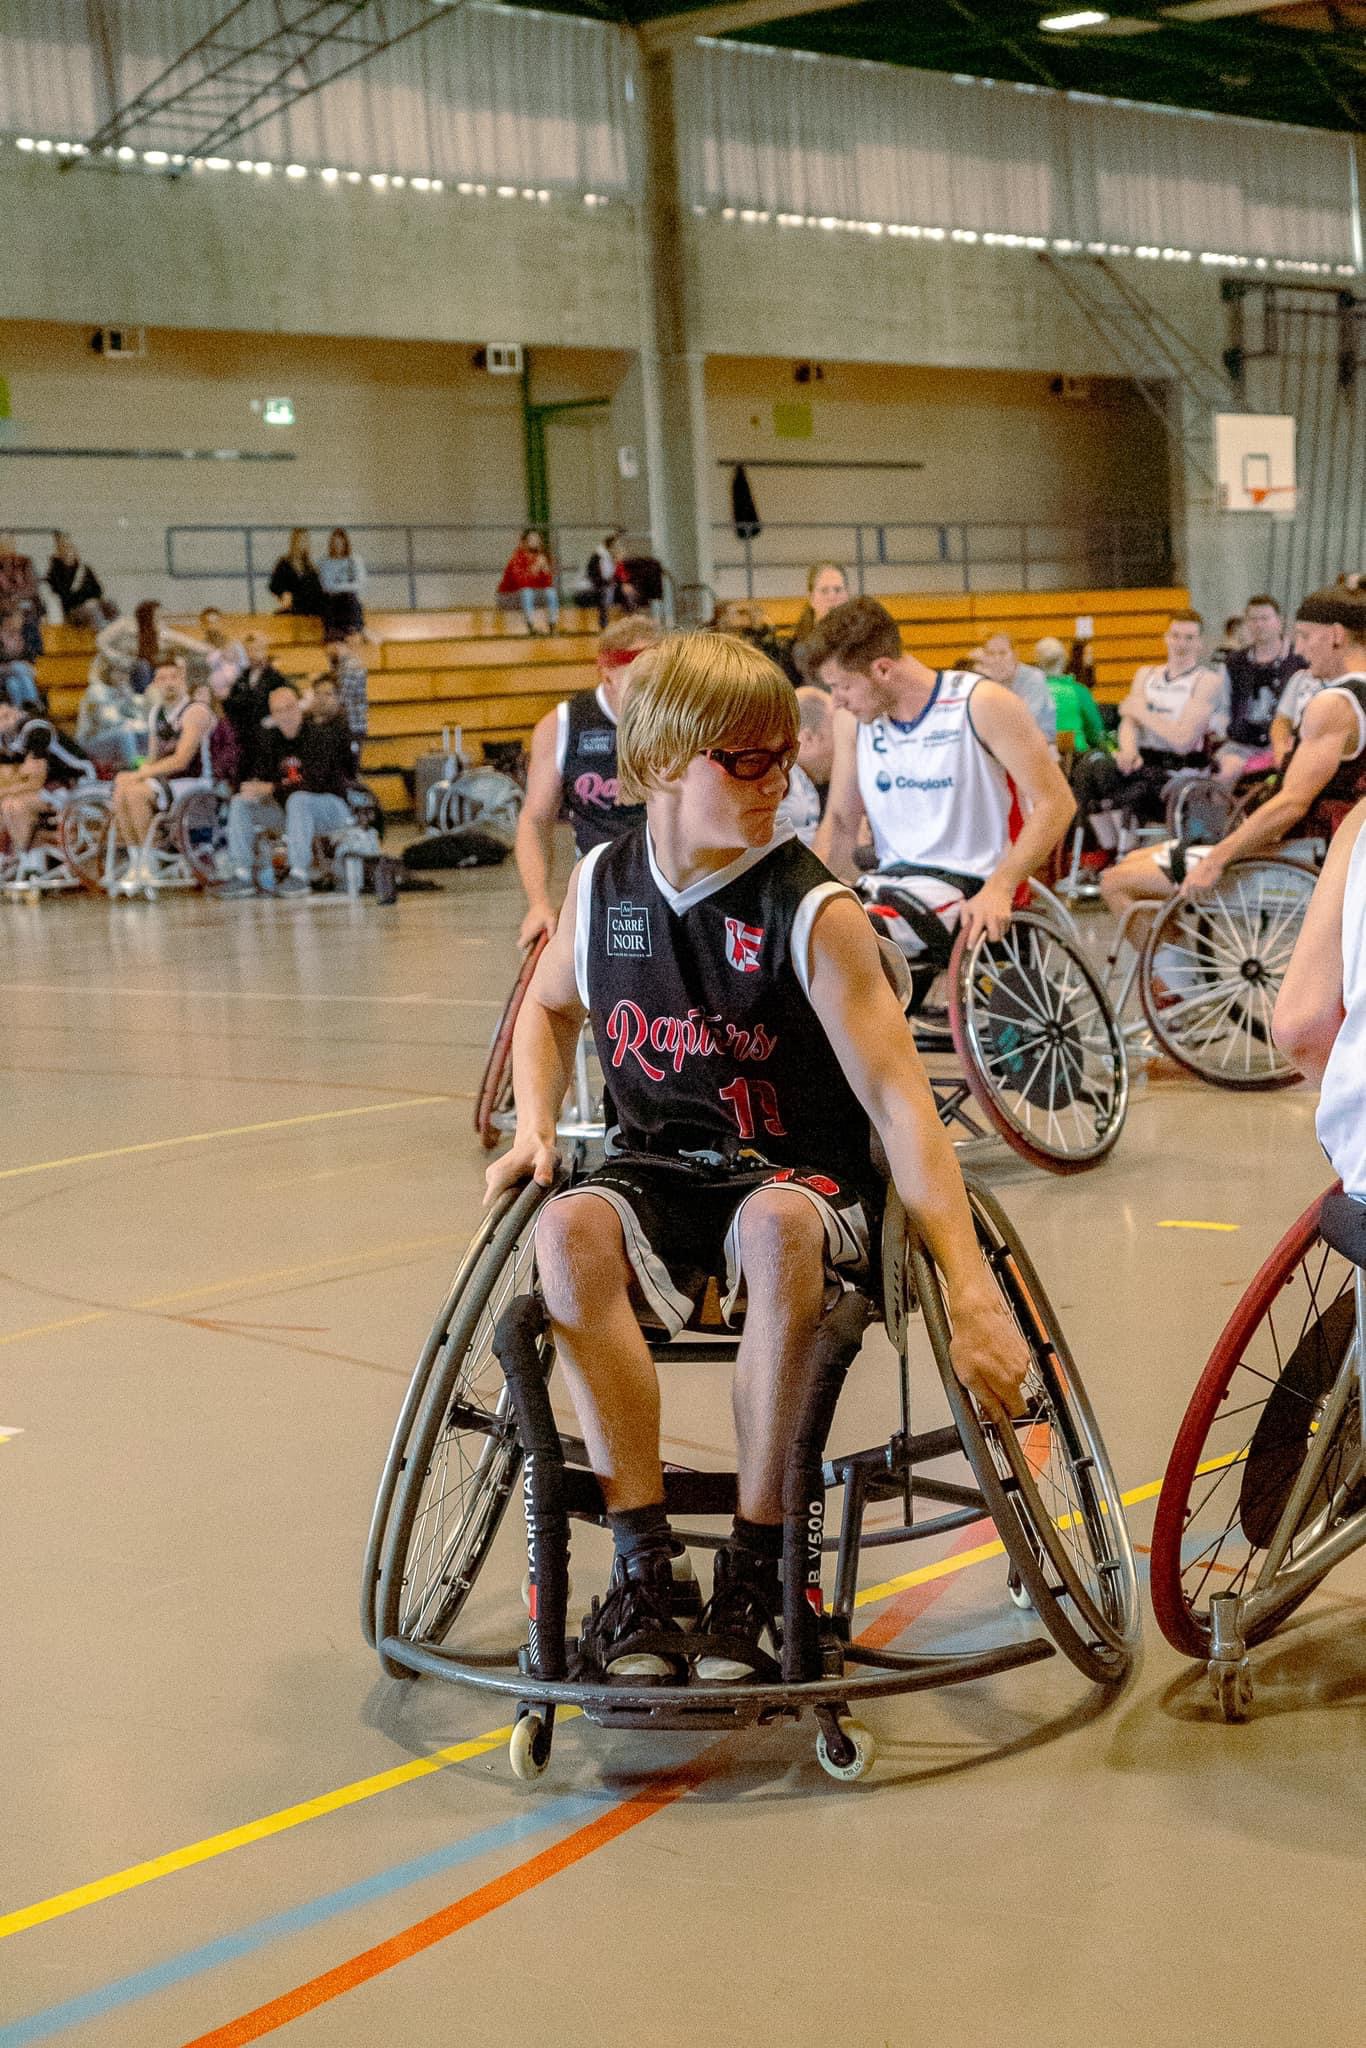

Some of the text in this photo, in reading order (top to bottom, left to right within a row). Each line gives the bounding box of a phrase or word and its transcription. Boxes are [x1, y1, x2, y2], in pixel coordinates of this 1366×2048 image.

[611, 916, 645, 932] CARRÉ
[612, 934, 646, 950] NOIR
[807, 1501, 822, 1560] V500
